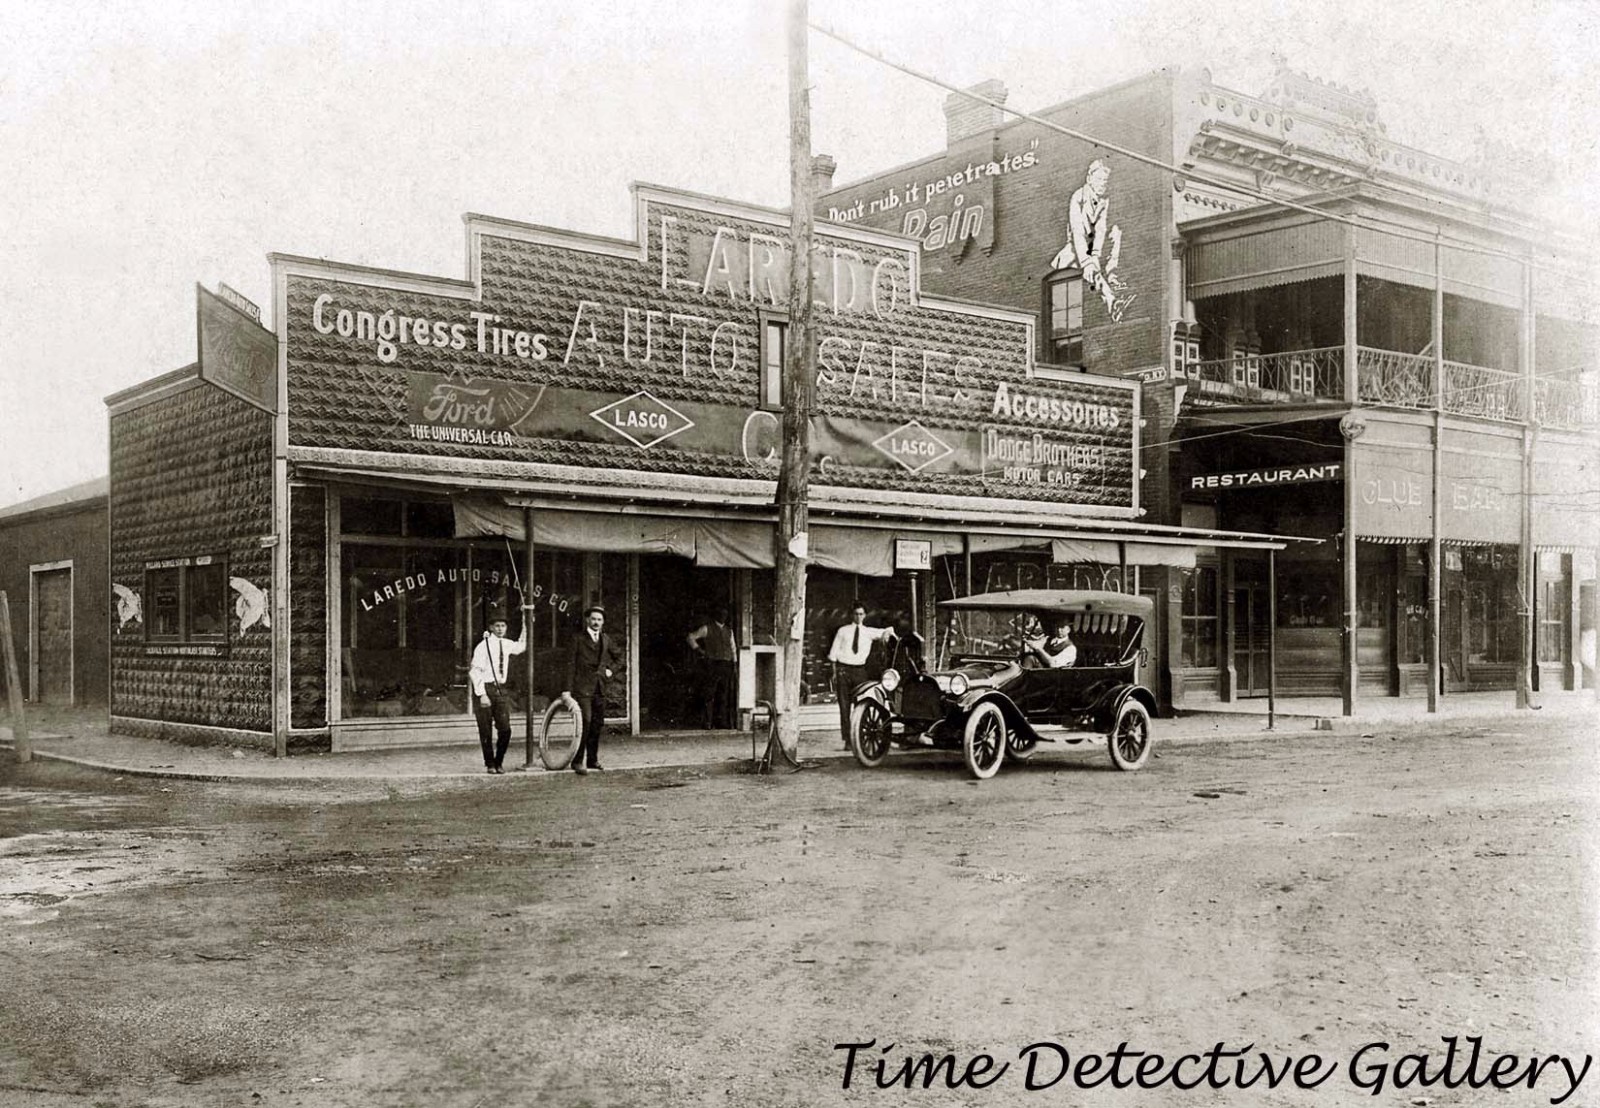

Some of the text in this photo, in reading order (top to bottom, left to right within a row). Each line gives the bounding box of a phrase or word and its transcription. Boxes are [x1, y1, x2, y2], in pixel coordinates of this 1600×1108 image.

[828, 200, 864, 221] Don't
[905, 182, 919, 204] it
[660, 215, 905, 319] LARDO
[312, 294, 466, 363] Congress
[469, 311, 548, 361] Tires
[564, 301, 983, 405] AUTO SALES
[423, 383, 496, 425] Ford
[615, 409, 668, 429] LASCO
[993, 382, 1119, 428] Accessories
[409, 424, 513, 446] THE UNIVERSAL CAR
[891, 438, 935, 456] LASCO
[987, 429, 1100, 467] DODGE BROTHERS
[1003, 466, 1081, 485] MOTOR CARS
[1191, 464, 1340, 489] RESTAURANT
[361, 573, 427, 611] LAREDO
[437, 568, 480, 583] AUTO
